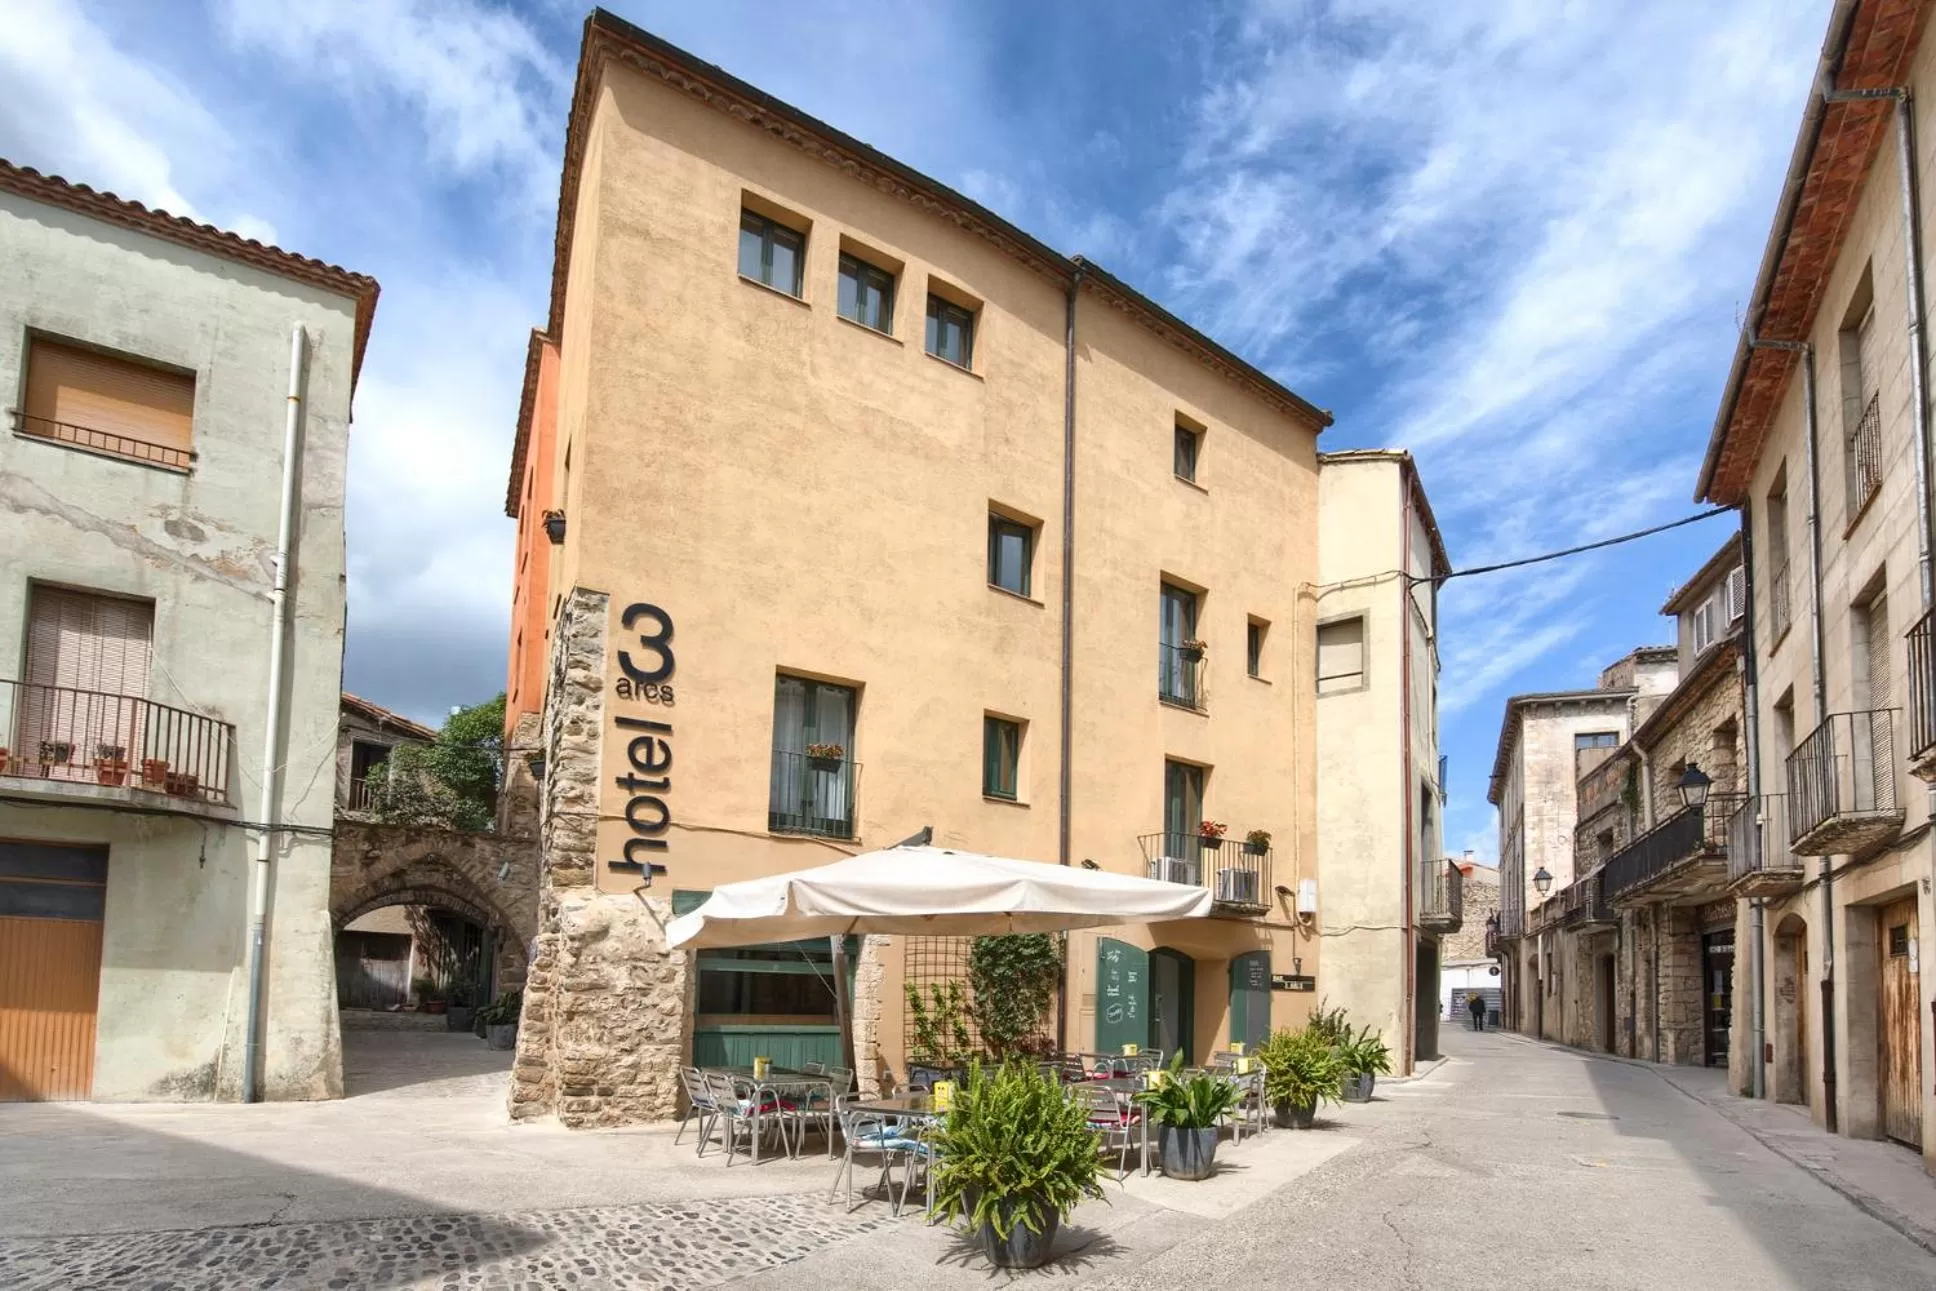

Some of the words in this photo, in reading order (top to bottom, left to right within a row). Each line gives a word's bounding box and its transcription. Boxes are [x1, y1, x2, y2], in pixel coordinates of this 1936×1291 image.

[617, 603, 675, 684] 3
[615, 677, 674, 703] arcs
[608, 716, 673, 873] hotel
